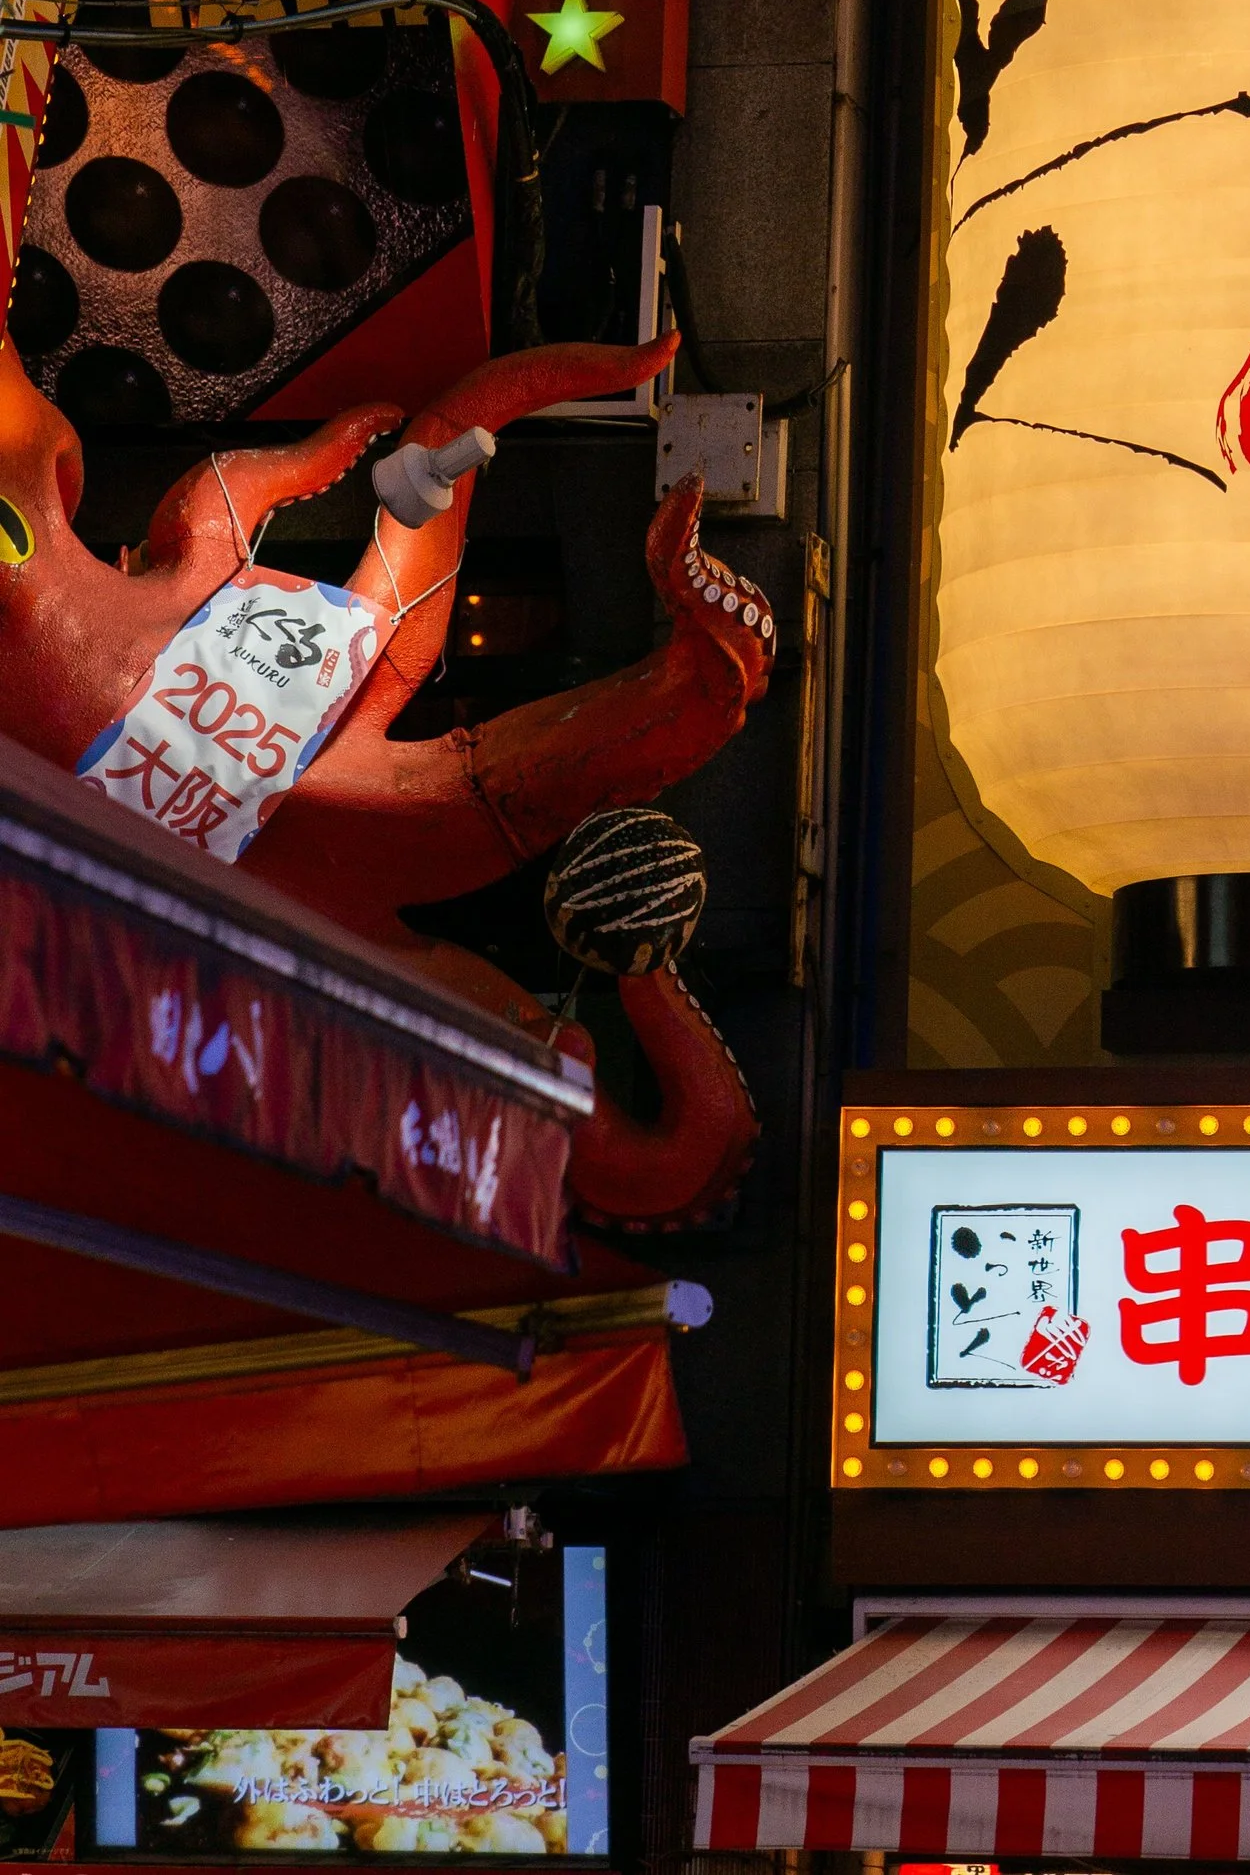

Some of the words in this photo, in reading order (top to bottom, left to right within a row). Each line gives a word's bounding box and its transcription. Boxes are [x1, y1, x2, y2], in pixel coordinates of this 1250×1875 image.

[229, 645, 291, 688] KUKURU
[152, 663, 302, 778] 2025
[105, 736, 243, 850] 大阪
[1026, 1229, 1062, 1303] 新世界
